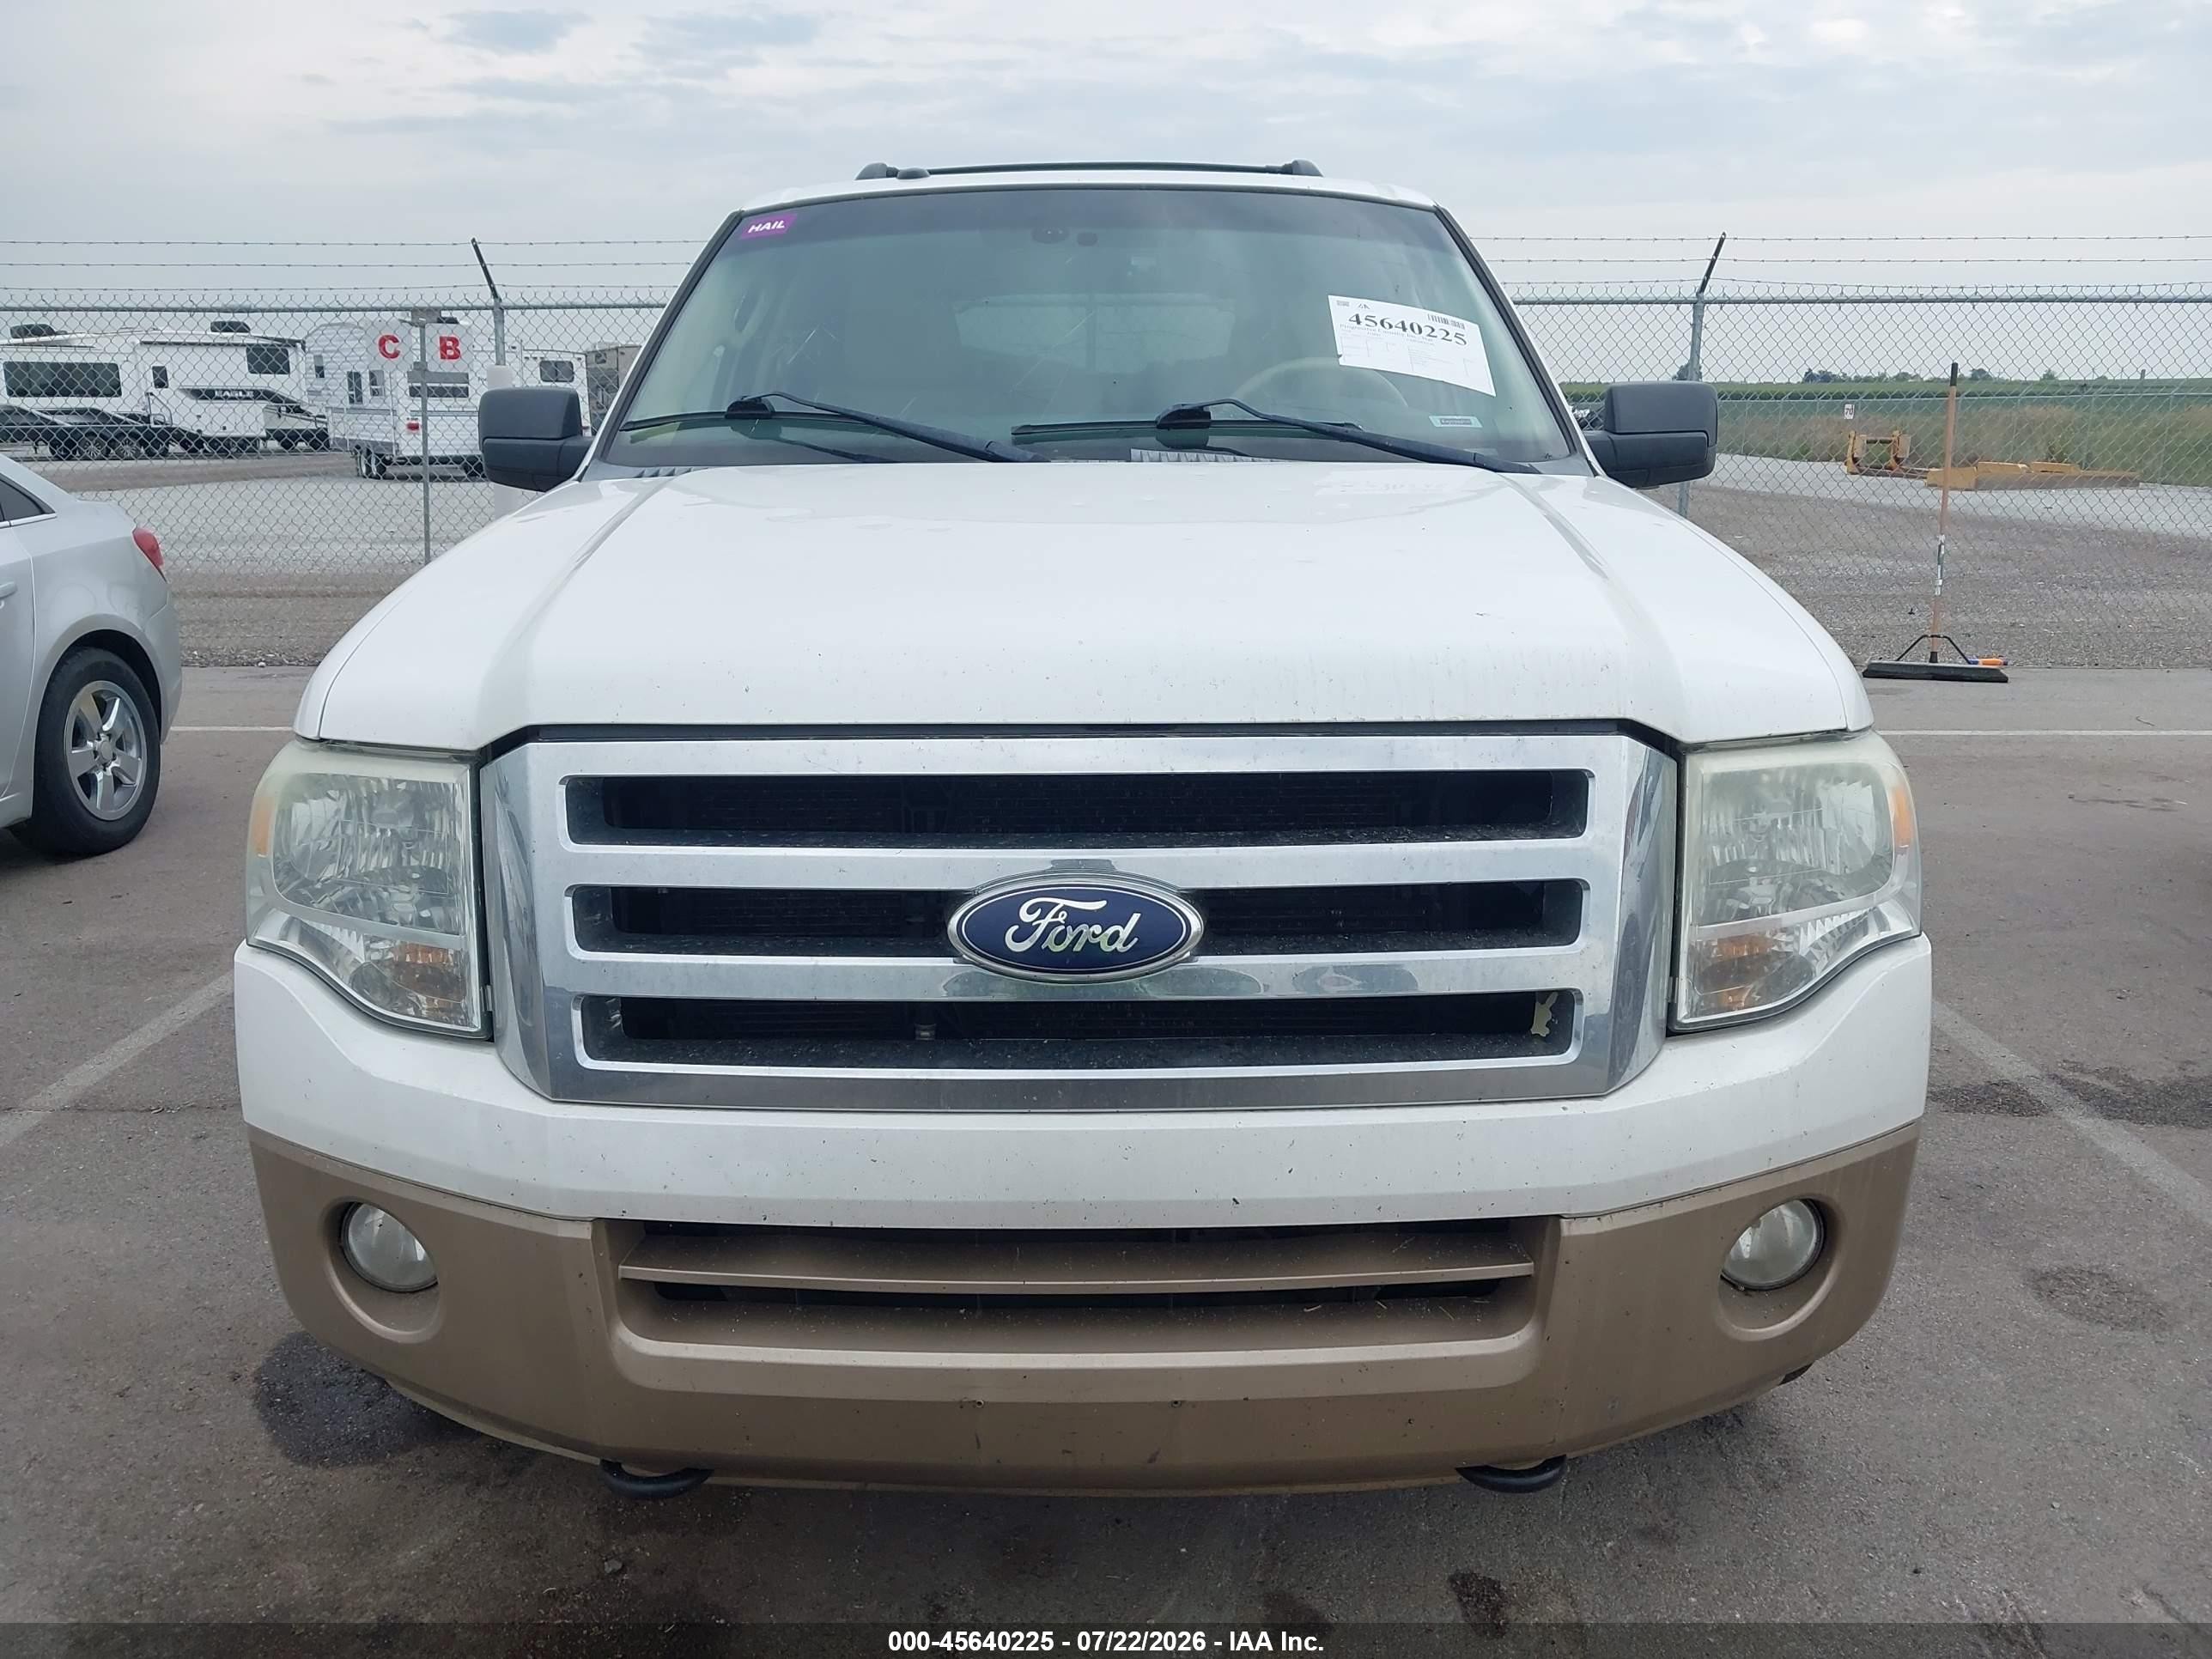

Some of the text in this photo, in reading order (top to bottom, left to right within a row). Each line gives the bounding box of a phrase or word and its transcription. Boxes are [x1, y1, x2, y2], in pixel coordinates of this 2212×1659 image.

[748, 220, 786, 234] HAIL
[1348, 313, 1468, 346] 45640225
[378, 334, 401, 359] C
[439, 336, 462, 360] B
[1005, 897, 1142, 953] Ford
